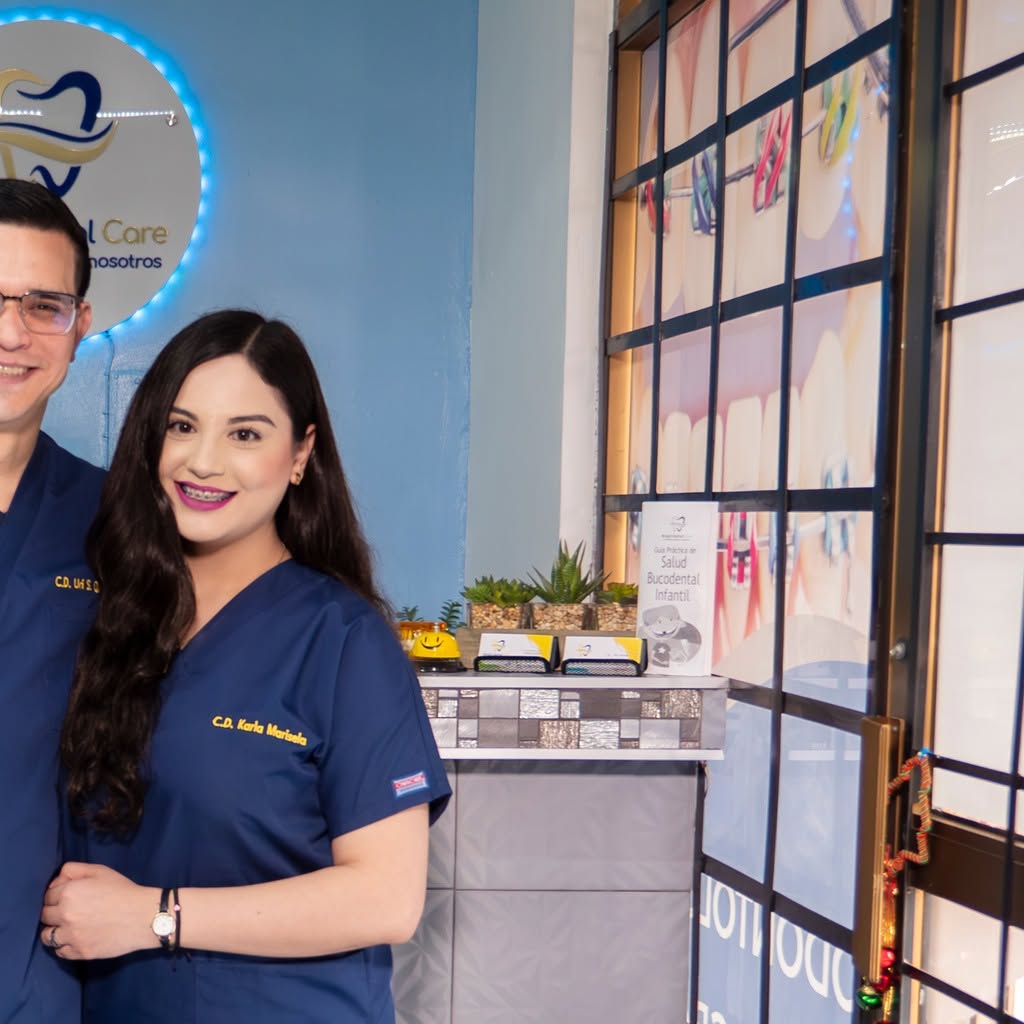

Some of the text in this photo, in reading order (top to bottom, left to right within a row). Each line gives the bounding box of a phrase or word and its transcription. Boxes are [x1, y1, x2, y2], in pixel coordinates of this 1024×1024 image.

[102, 217, 169, 244] Care
[89, 254, 162, 268] nosotros
[661, 555, 687, 568] Salud
[647, 571, 700, 586] Bucodental
[655, 588, 690, 602] Infantil
[237, 718, 264, 734] Karla
[266, 722, 308, 746] Marisela
